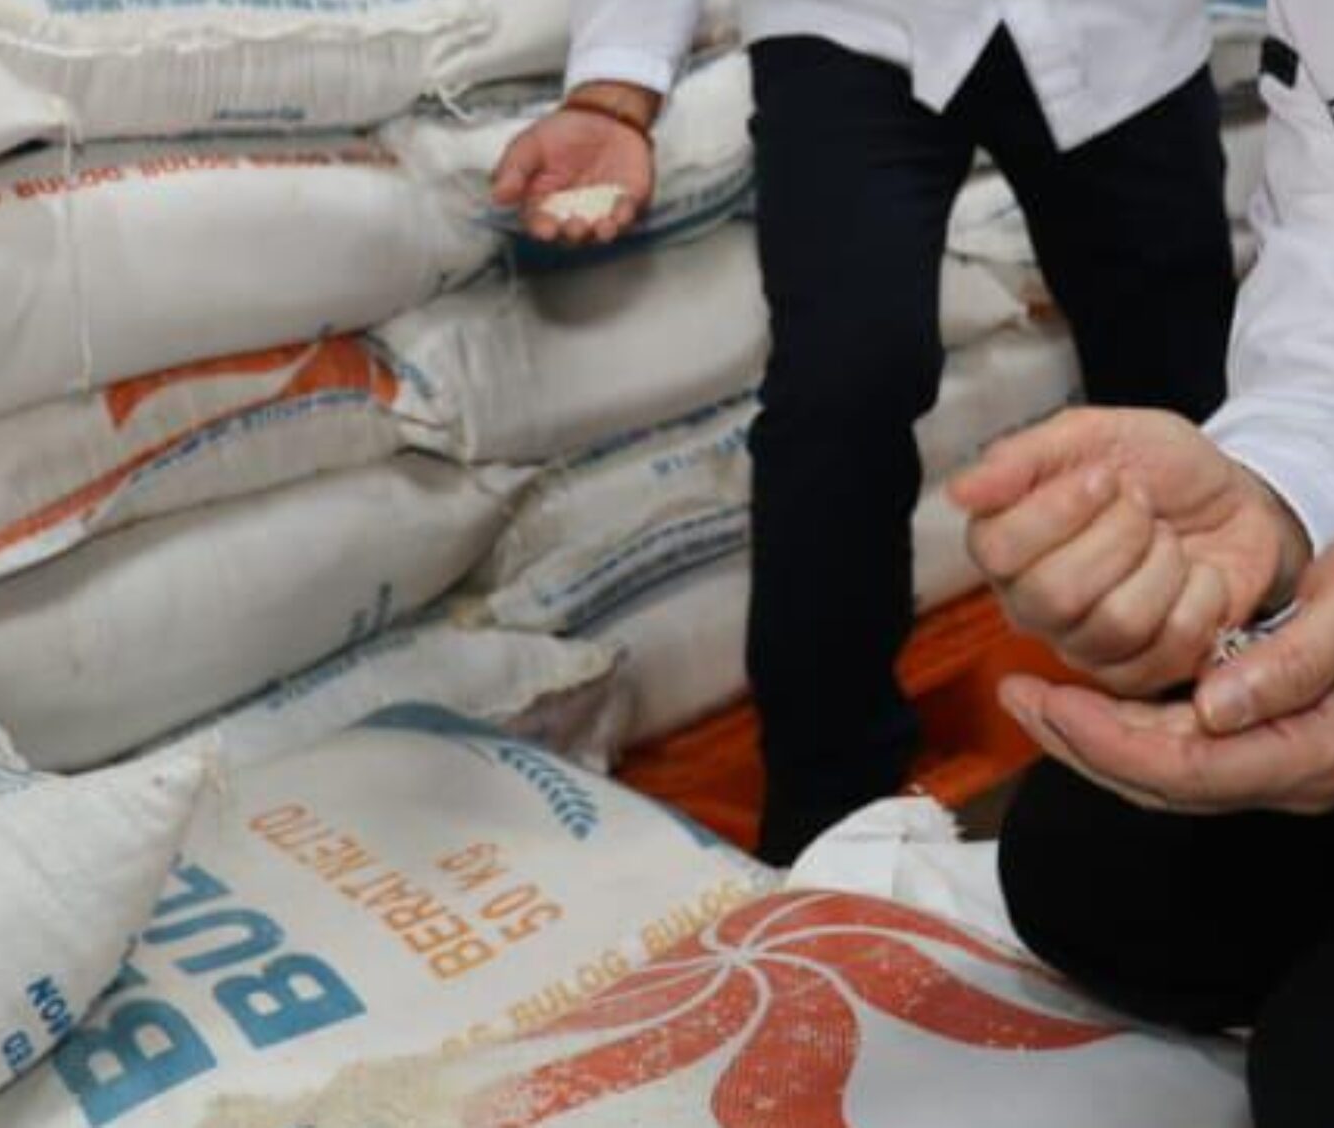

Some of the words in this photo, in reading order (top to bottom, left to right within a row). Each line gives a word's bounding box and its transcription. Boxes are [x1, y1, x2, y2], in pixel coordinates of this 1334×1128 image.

[14, 164, 125, 201] BULOG
[480, 884, 565, 946] 50
[508, 946, 630, 1029] BULOG
